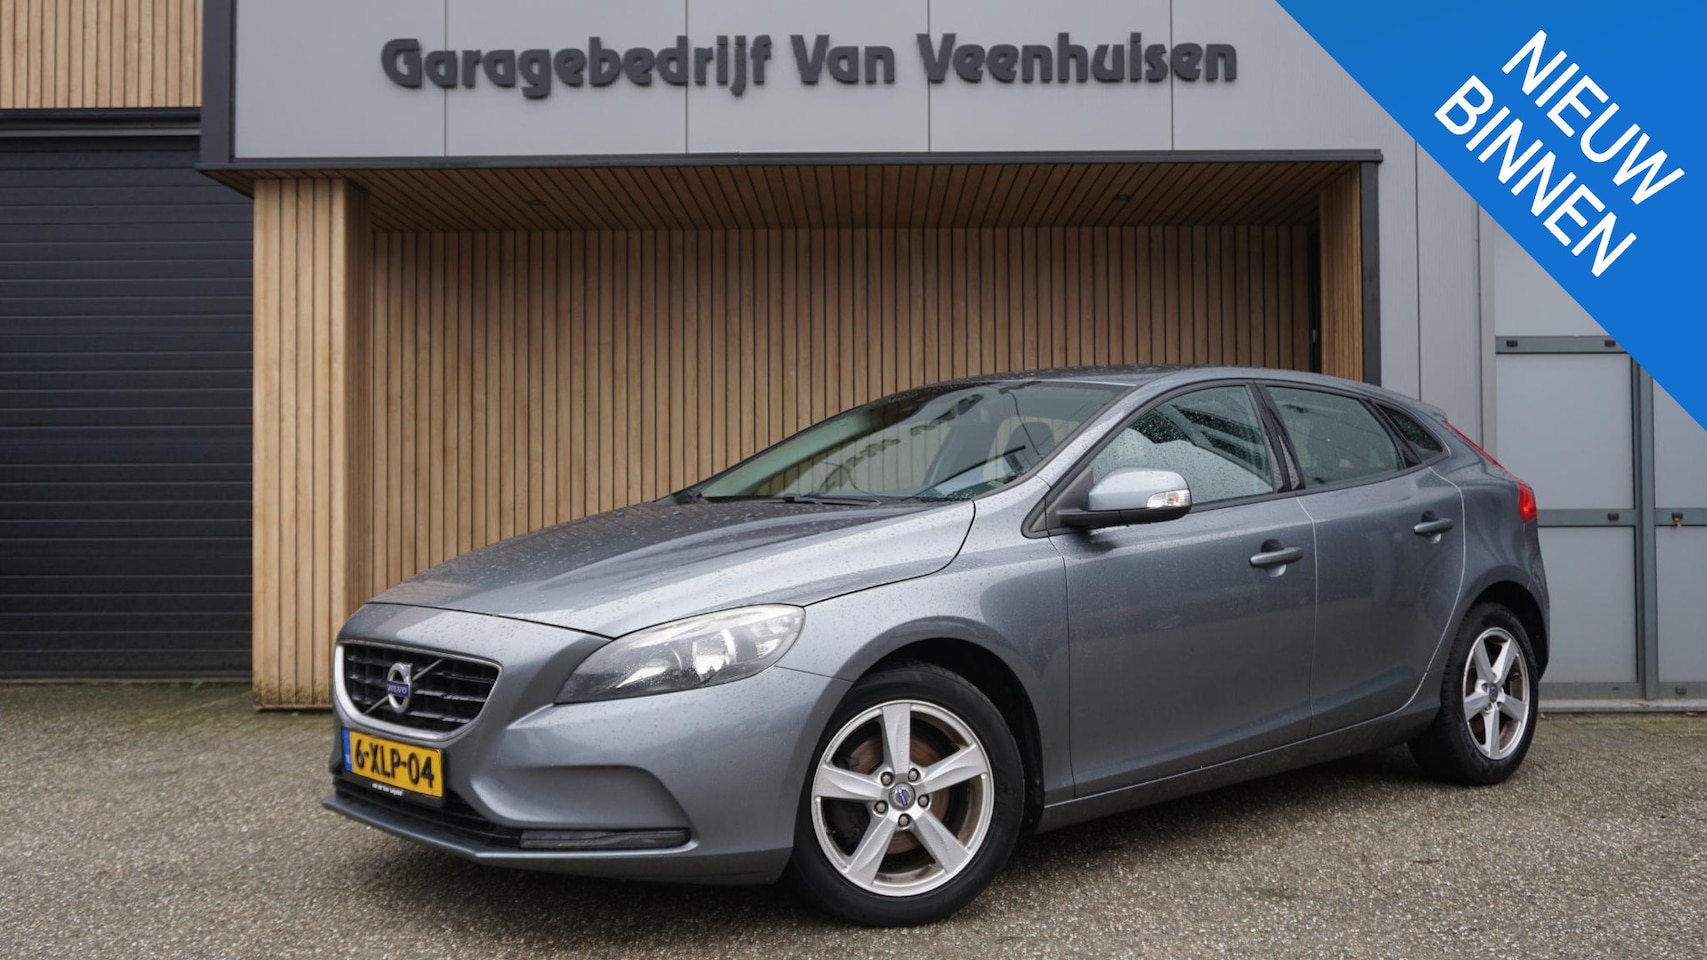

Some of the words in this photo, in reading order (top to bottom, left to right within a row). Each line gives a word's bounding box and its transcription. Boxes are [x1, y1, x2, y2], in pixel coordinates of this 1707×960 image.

[381, 35, 772, 98] Garagebedrijf
[789, 34, 896, 86] Van
[917, 32, 1238, 84] Veenhuisen
[387, 683, 407, 695] VOLVO
[355, 739, 435, 788] 6-XLP-04
